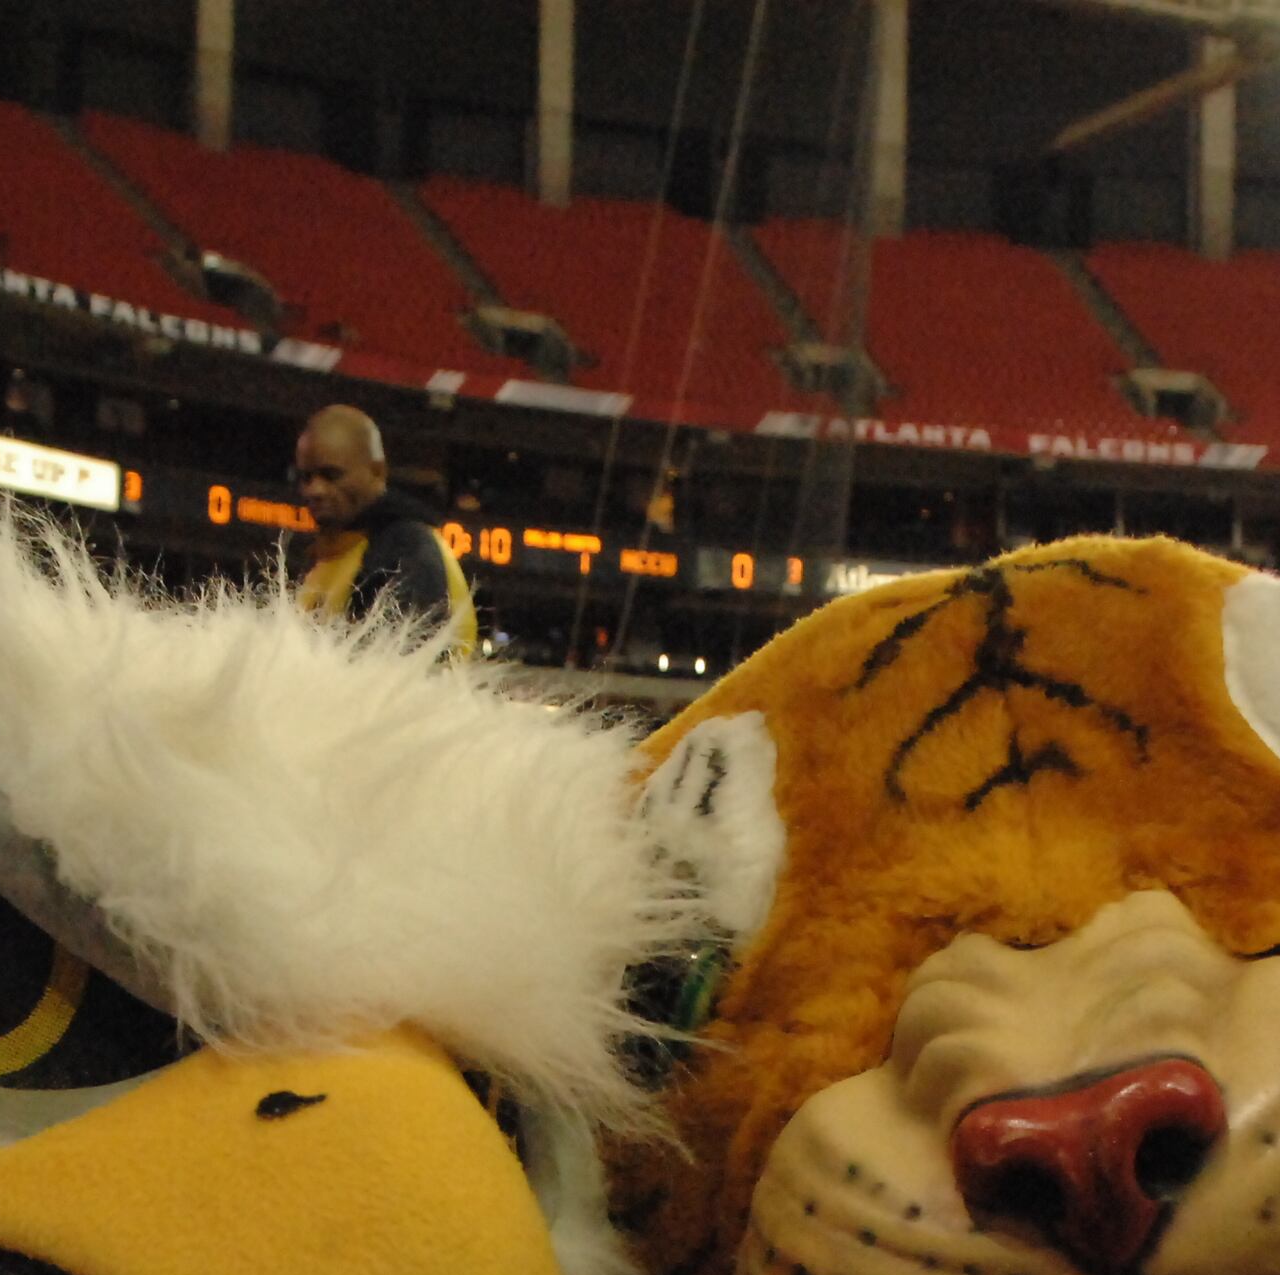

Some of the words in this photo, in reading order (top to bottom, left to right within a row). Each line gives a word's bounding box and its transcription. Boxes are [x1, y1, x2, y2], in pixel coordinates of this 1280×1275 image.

[90, 295, 263, 353] FALCONS
[827, 415, 993, 451] ATLANTA
[1028, 432, 1198, 467] FALCONS
